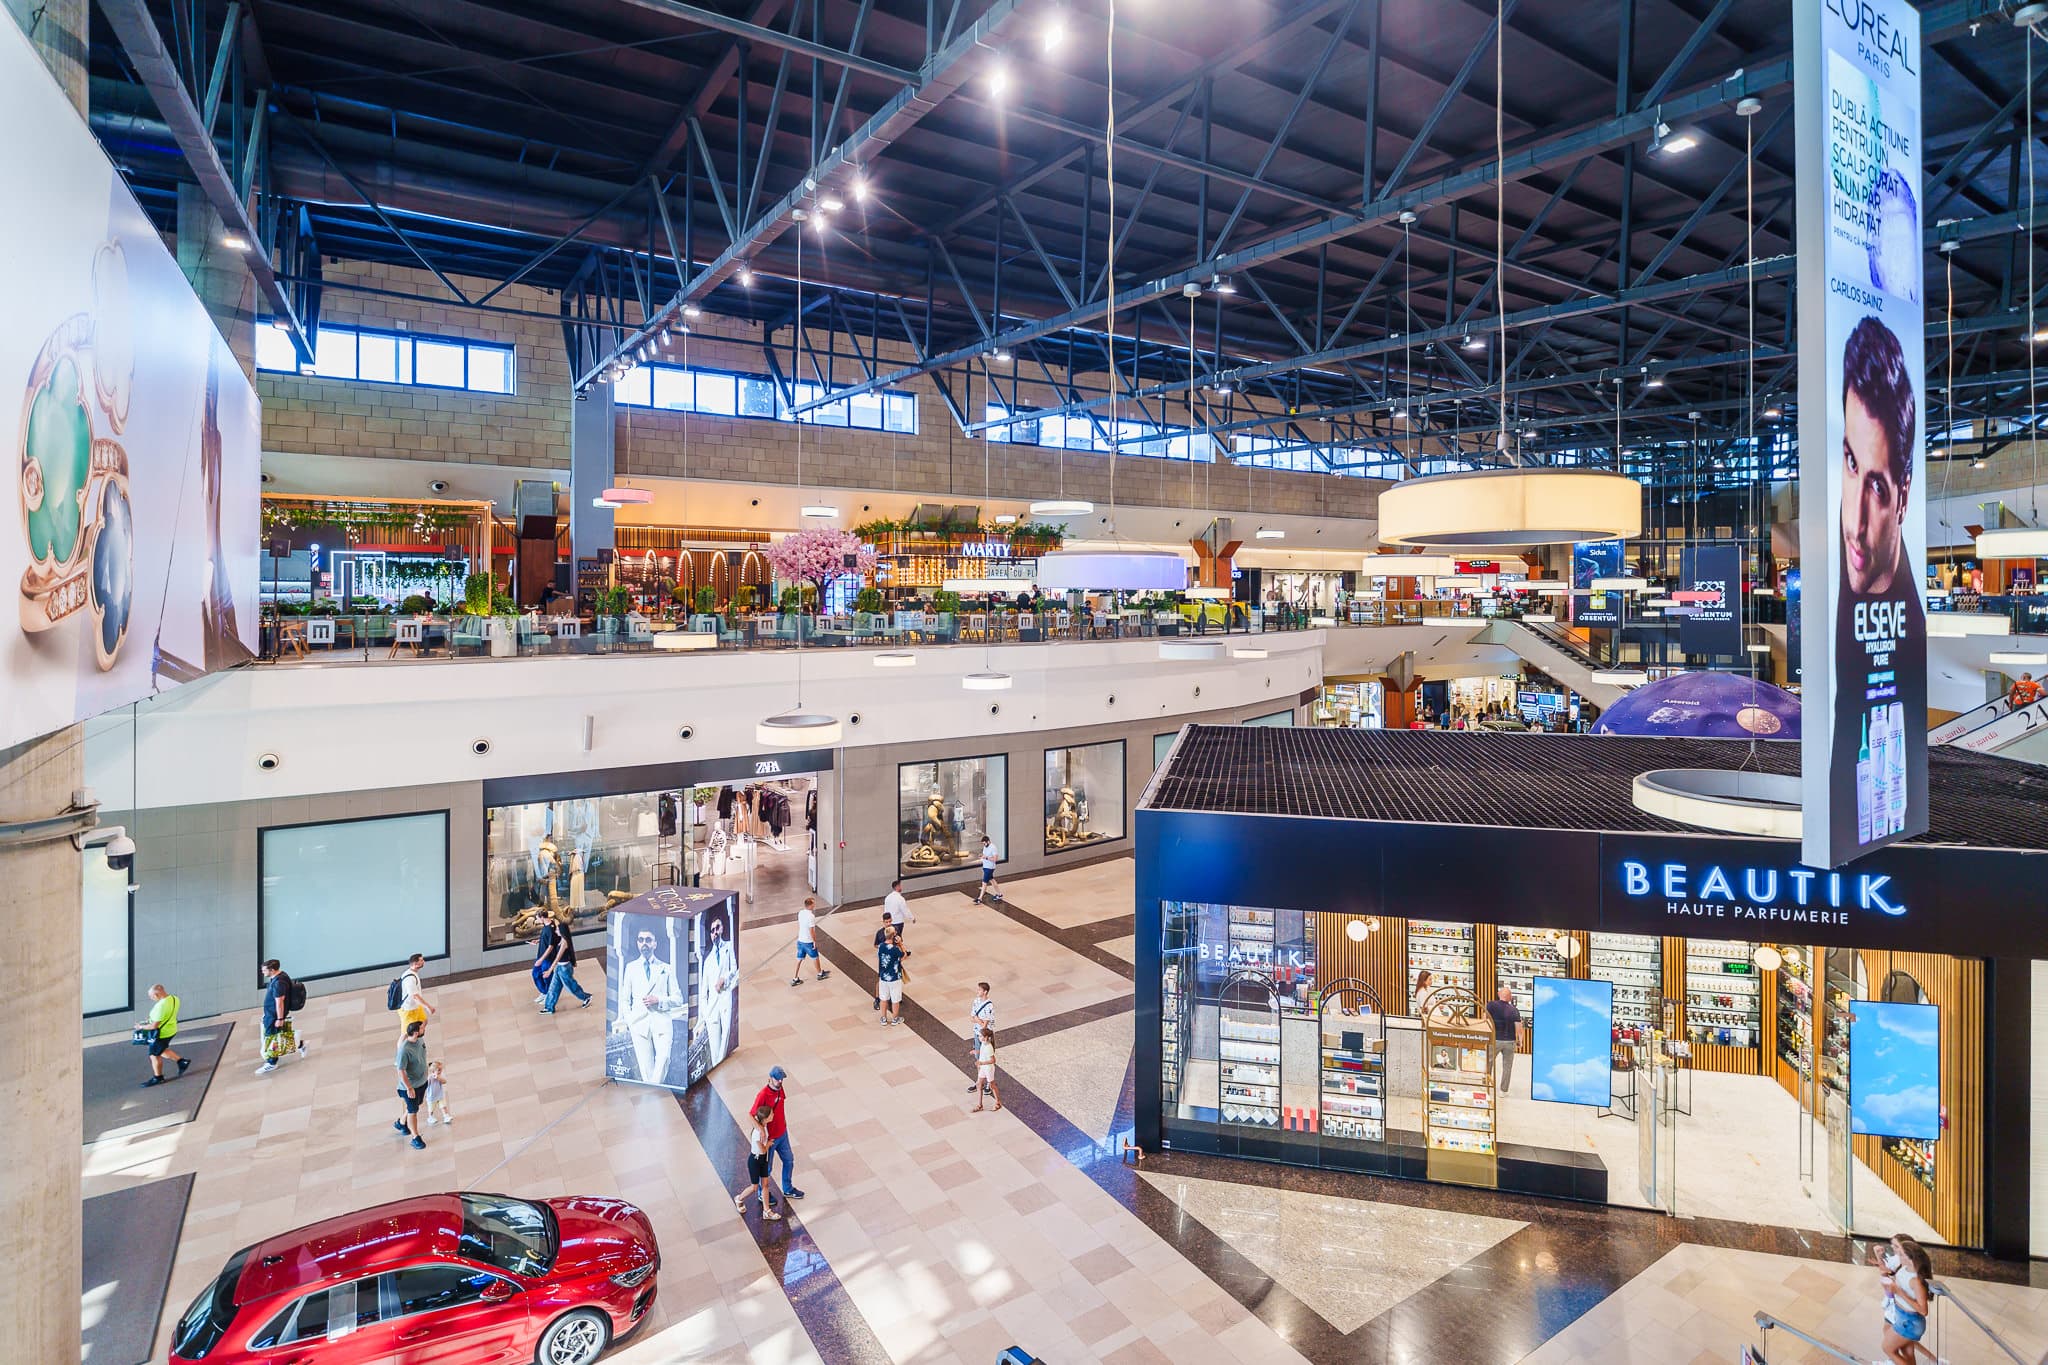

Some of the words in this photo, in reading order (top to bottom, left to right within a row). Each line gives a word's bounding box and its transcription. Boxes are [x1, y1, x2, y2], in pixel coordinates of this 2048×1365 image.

[1826, 0, 1916, 76] ORÉAL
[1858, 41, 1890, 79] PARIS
[1832, 115, 1873, 158] PENTRU
[1874, 139, 1889, 168] UN
[1832, 142, 1866, 177] SCALP
[1867, 164, 1899, 198] CURAT
[1844, 175, 1861, 201] UN
[1833, 193, 1882, 238] HIDRATAT
[1831, 278, 1861, 303] CARLOS
[1862, 290, 1883, 312] SAINZ
[962, 543, 1011, 557] MARTY
[1854, 600, 1906, 642] ELSEVE
[1865, 640, 1897, 654] HYALURON
[1873, 654, 1889, 666] PURE
[755, 761, 781, 774] ZARA
[1623, 862, 1907, 915] BEAUTIK
[1667, 902, 1724, 917] HAUTE
[1735, 906, 1849, 924] PARFUMERIE
[1199, 943, 1306, 968] BEAUTIK
